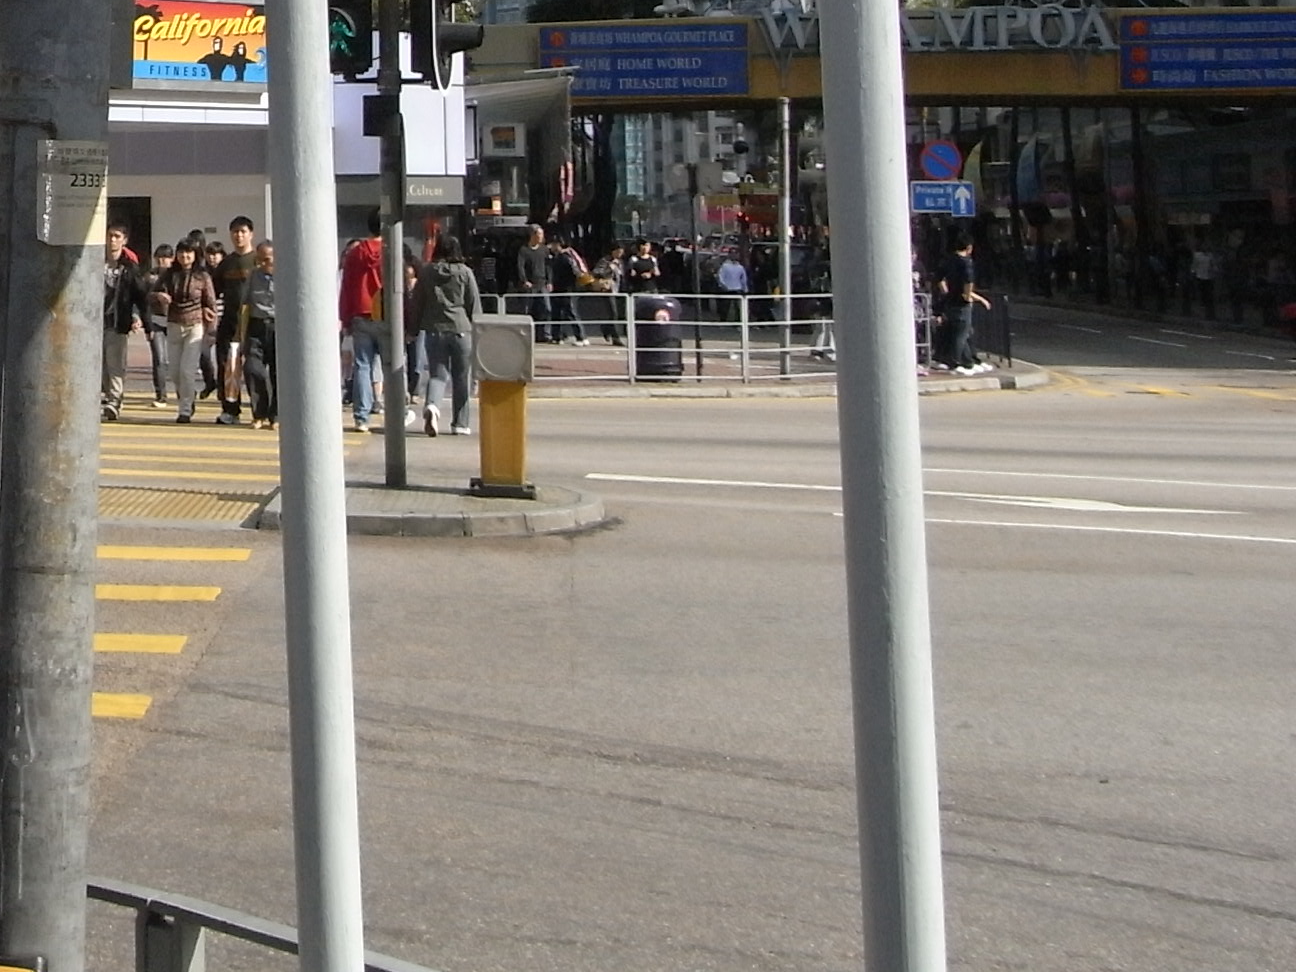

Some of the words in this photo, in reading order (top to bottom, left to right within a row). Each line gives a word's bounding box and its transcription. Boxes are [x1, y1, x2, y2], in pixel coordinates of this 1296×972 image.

[134, 8, 266, 45] California
[615, 31, 664, 44] WHAMPOA
[664, 31, 706, 43] GOURMET
[708, 30, 735, 43] PLACE
[149, 64, 207, 77] FITNESS
[617, 58, 654, 70] HOME
[657, 57, 702, 70] WORLD
[618, 77, 680, 90] TREASURE
[682, 76, 729, 89] WORLD
